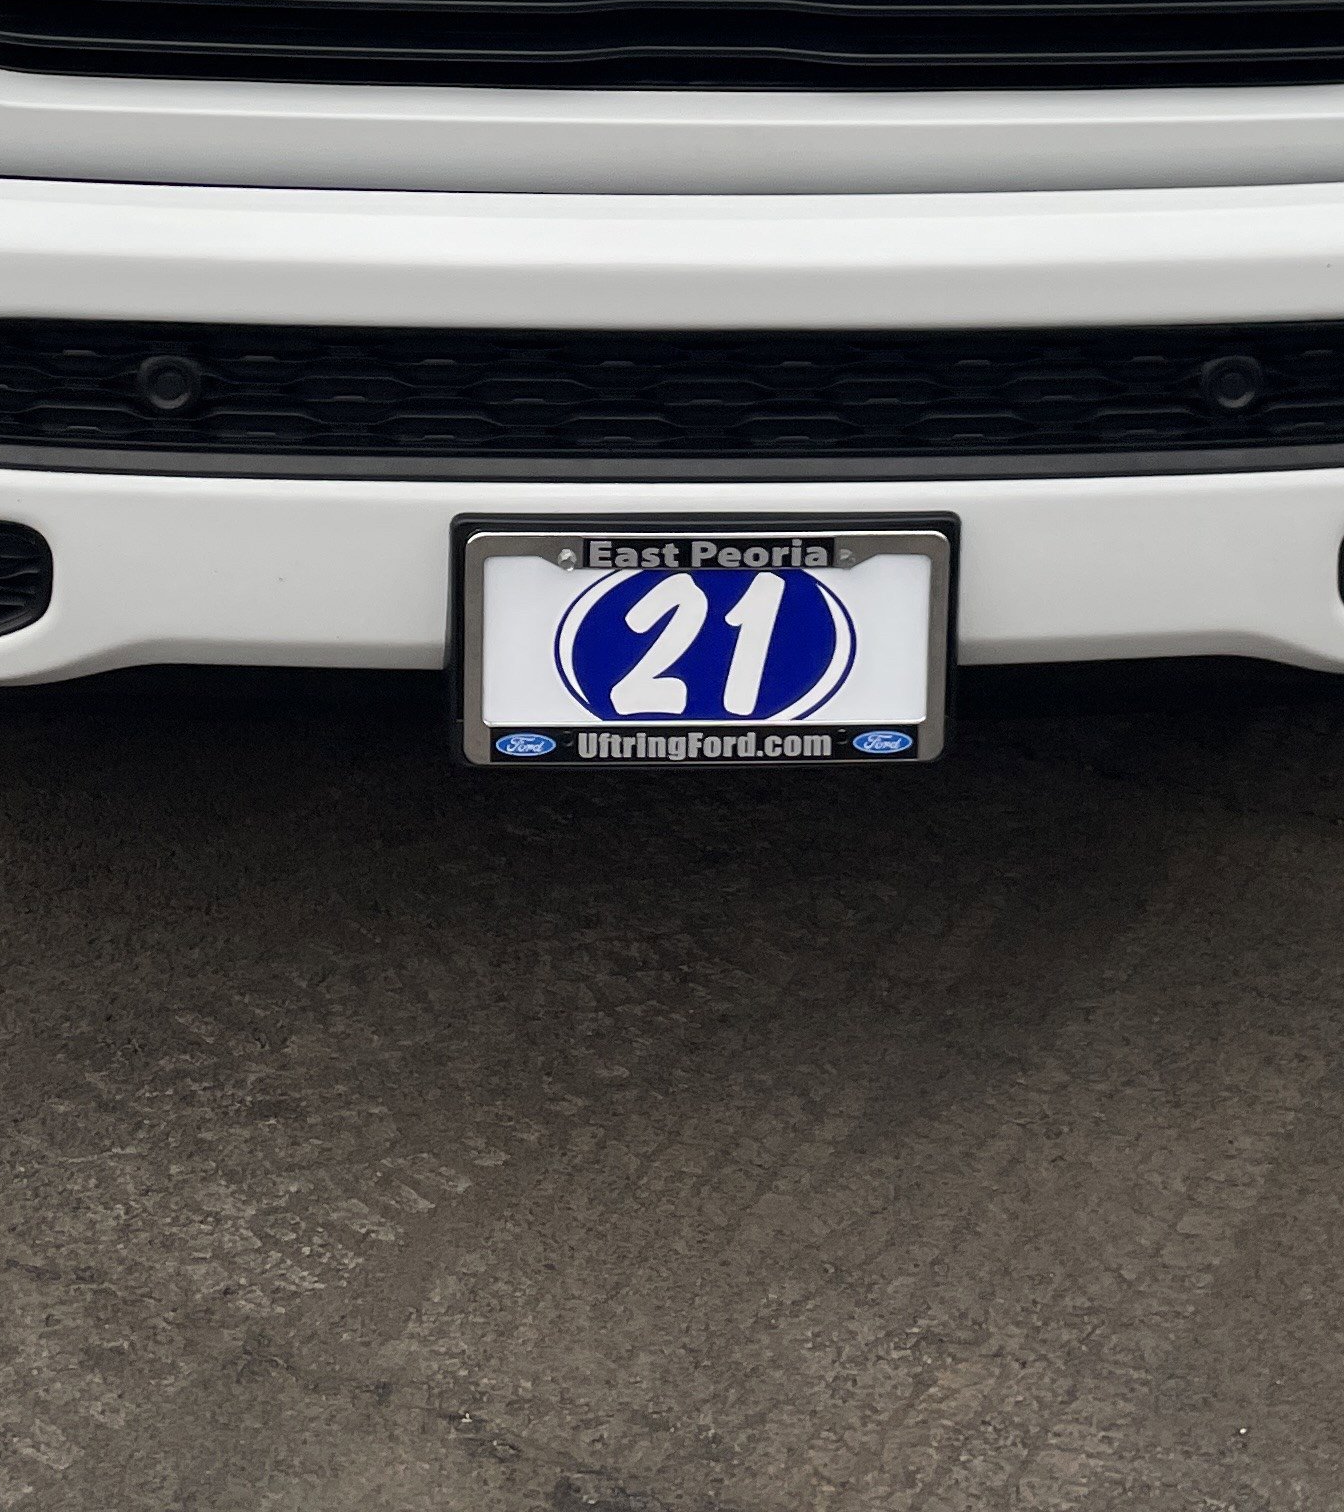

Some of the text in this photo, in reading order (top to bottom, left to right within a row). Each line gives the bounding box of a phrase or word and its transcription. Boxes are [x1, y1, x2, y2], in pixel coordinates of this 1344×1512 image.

[589, 538, 829, 568] East Peoria
[609, 571, 786, 716] 21
[577, 731, 832, 761] UftringFord.com
